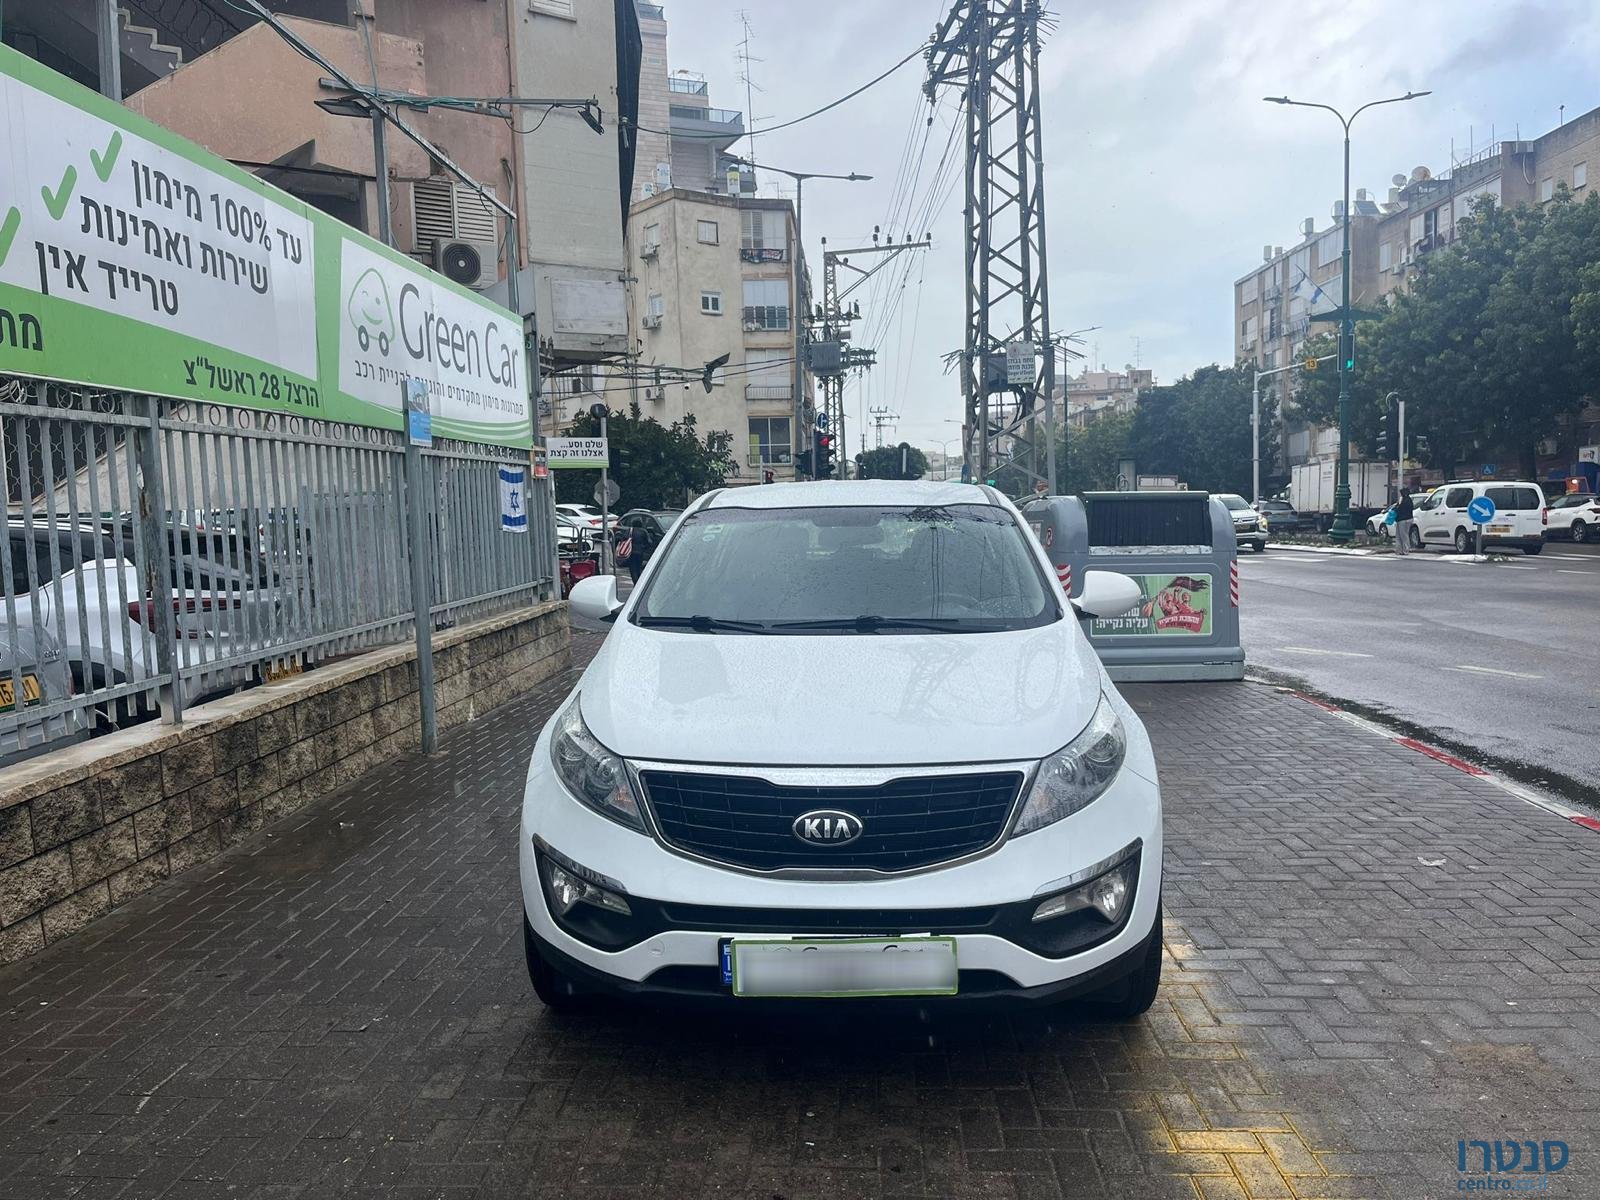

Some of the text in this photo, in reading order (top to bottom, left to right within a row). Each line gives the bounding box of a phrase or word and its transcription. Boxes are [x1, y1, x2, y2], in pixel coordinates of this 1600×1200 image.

[131, 159, 302, 264] עד 100% מימון
[80, 195, 268, 294] שירות ואמינות
[35, 241, 178, 315] טרייד אין
[399, 282, 519, 389] Green Car
[355, 360, 375, 380] רכב
[260, 371, 281, 400] 28
[282, 375, 319, 408] הרצל
[482, 394, 499, 411] מימון
[550, 449, 568, 458] קצת
[585, 440, 603, 448] שלם
[804, 818, 852, 838] KIA
